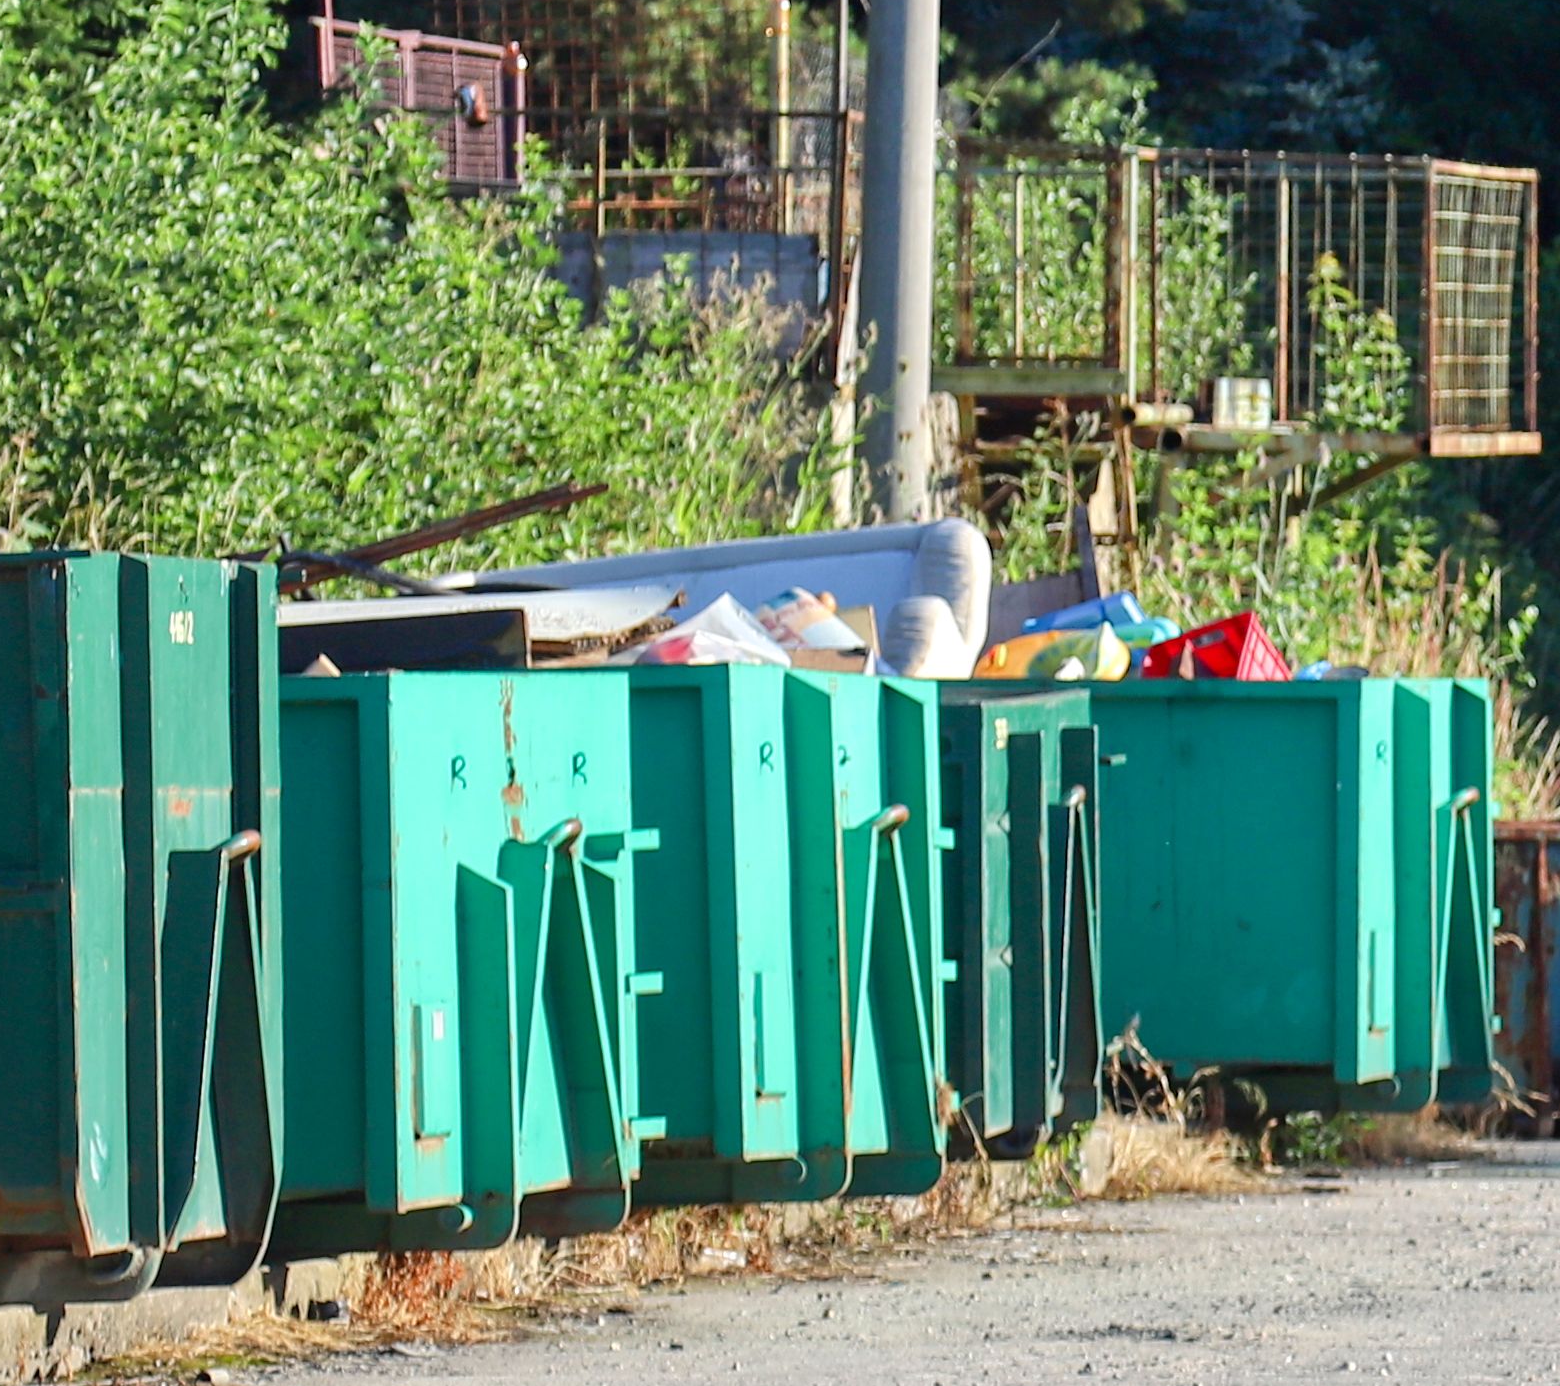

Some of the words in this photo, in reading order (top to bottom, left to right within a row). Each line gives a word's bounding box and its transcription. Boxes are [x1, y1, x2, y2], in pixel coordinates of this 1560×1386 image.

[451, 755, 466, 793] R
[572, 751, 587, 788] R
[760, 741, 773, 775] R
